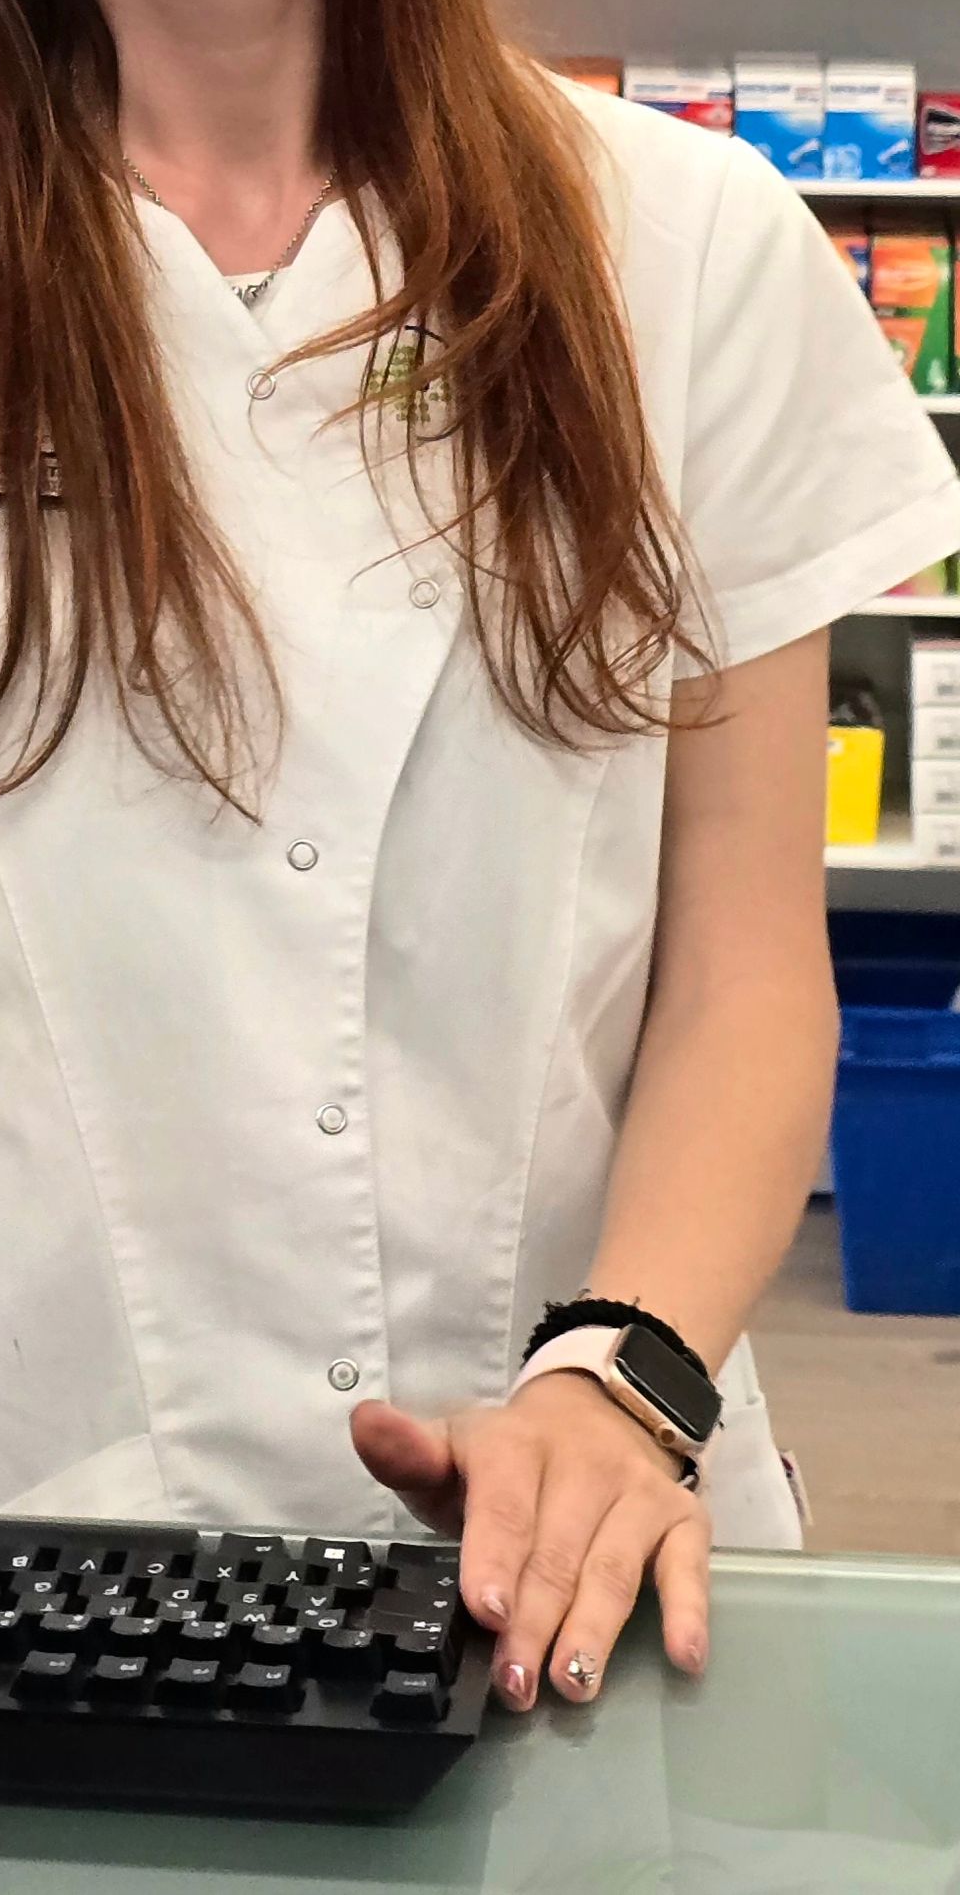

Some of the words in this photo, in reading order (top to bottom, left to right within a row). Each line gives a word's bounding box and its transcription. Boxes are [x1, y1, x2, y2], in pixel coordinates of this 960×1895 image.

[12, 1555, 29, 1567] B
[79, 1559, 96, 1570] V
[147, 1563, 165, 1574] C
[217, 1566, 232, 1578] X
[285, 1570, 300, 1581] Y
[34, 1581, 52, 1593] G
[103, 1584, 119, 1596] F
[172, 1589, 190, 1600] D
[242, 1593, 258, 1604] S
[310, 1596, 327, 1607] A
[40, 1603, 55, 1612] T
[243, 1613, 266, 1622] W
[317, 1617, 339, 1628] Q
